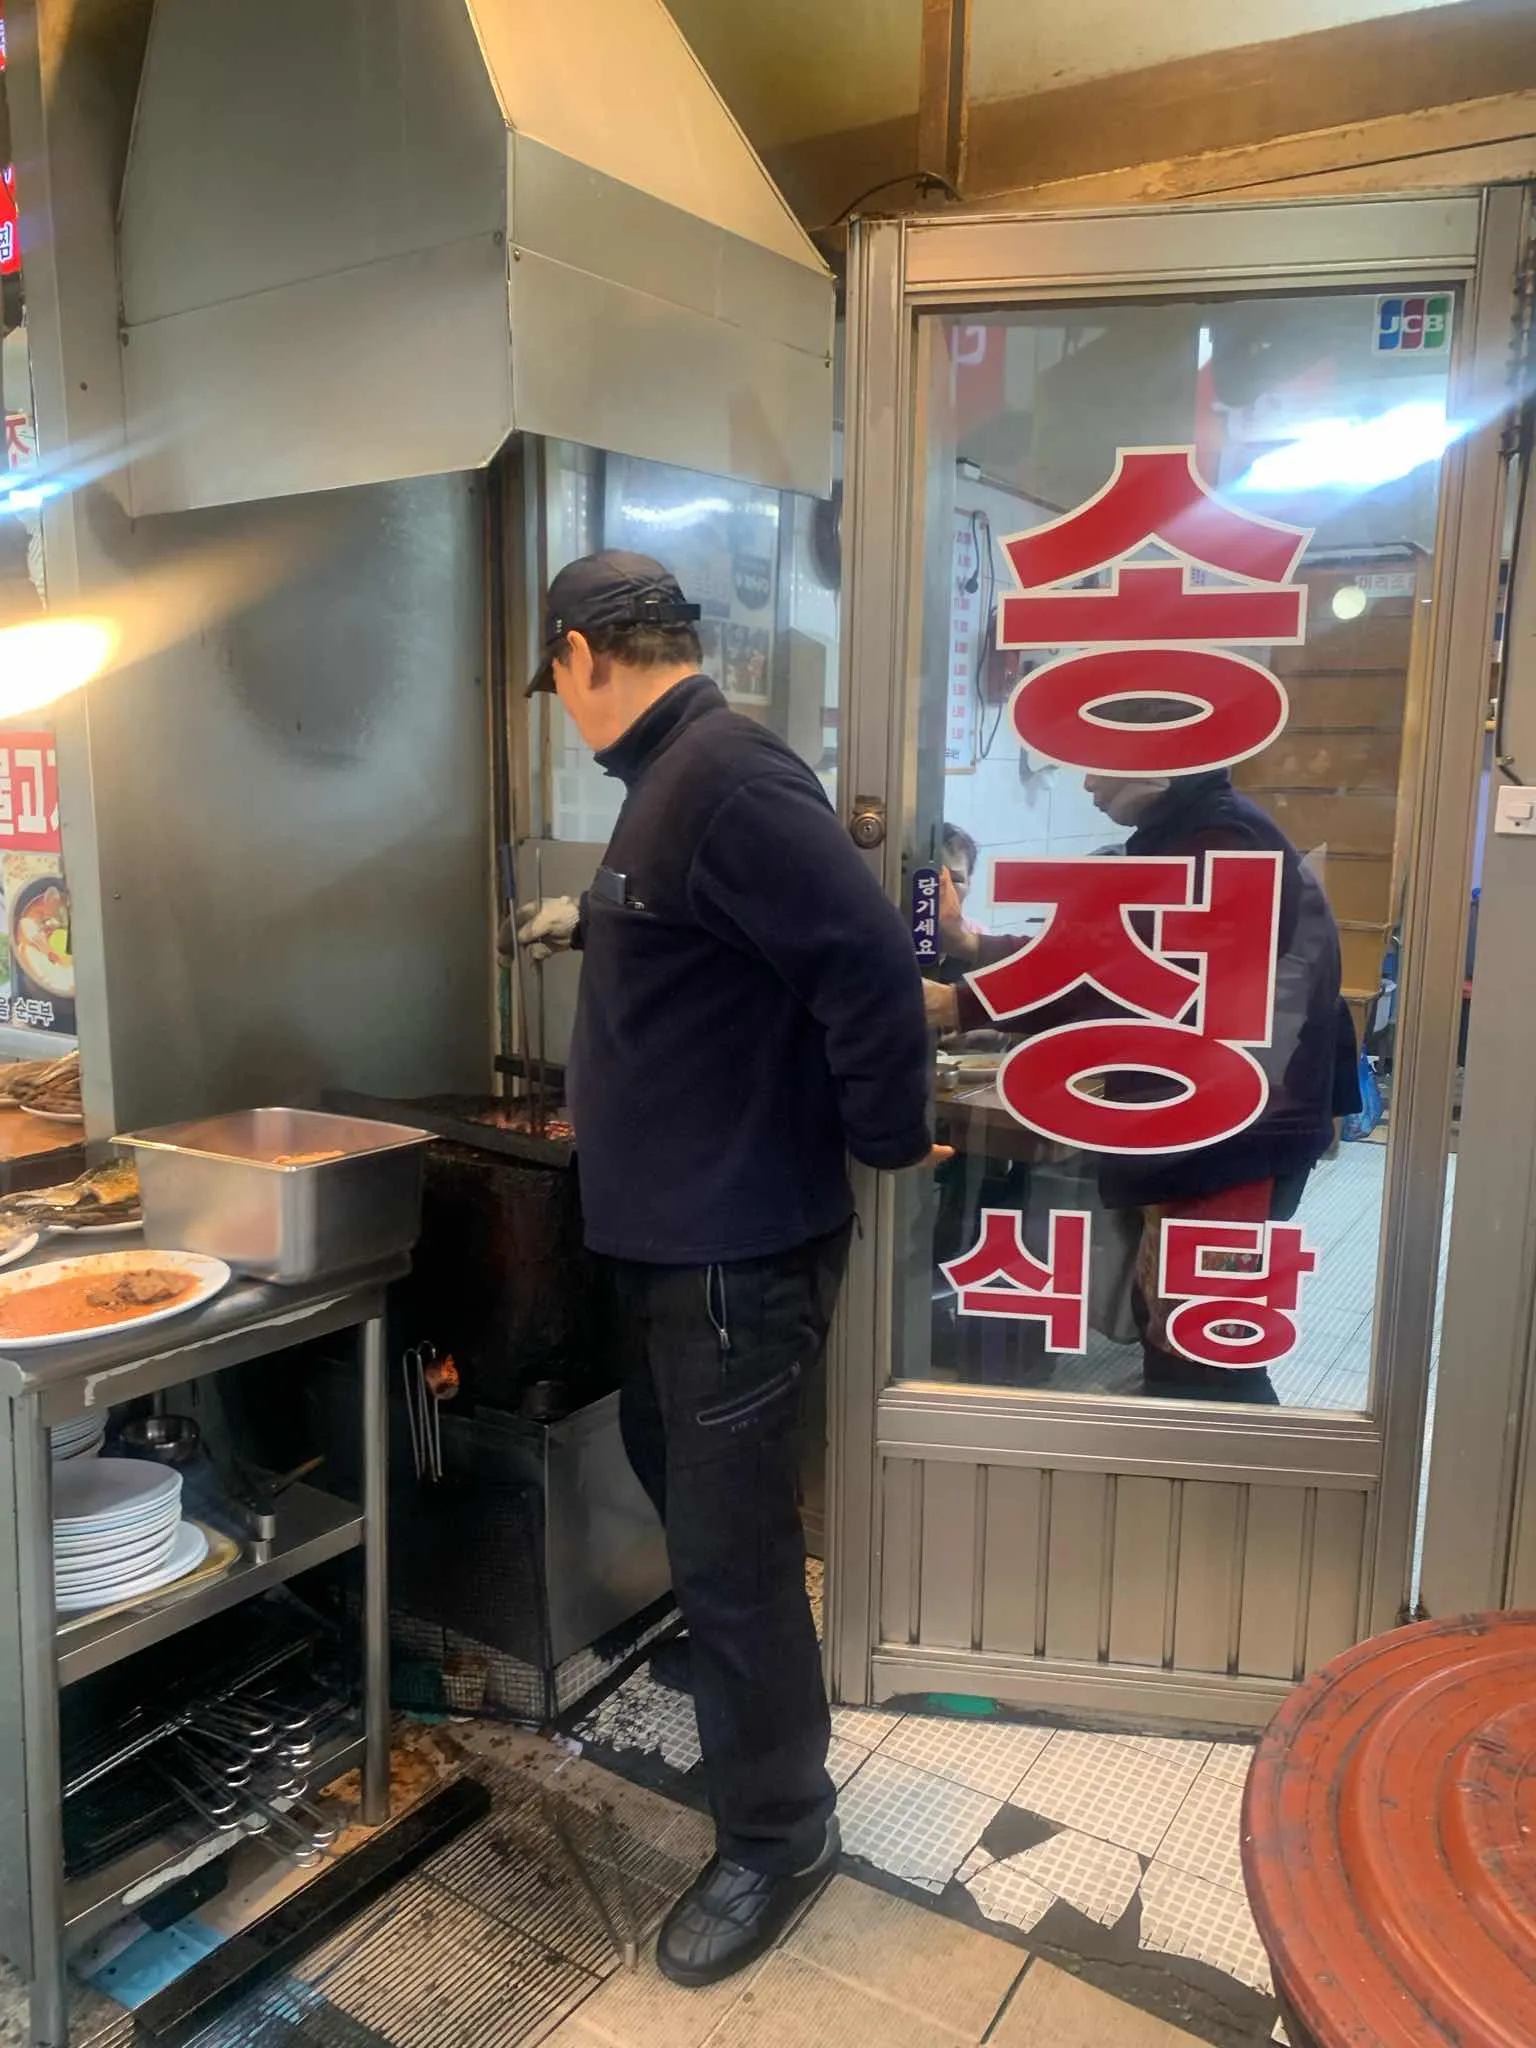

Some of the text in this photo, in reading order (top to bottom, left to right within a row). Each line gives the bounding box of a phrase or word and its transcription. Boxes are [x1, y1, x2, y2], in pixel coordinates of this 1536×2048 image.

[1379, 314, 1444, 334] JCB
[914, 877, 938, 955] 당기세요
[13, 997, 54, 1027] 순두부
[939, 1208, 1320, 1369] 식당
